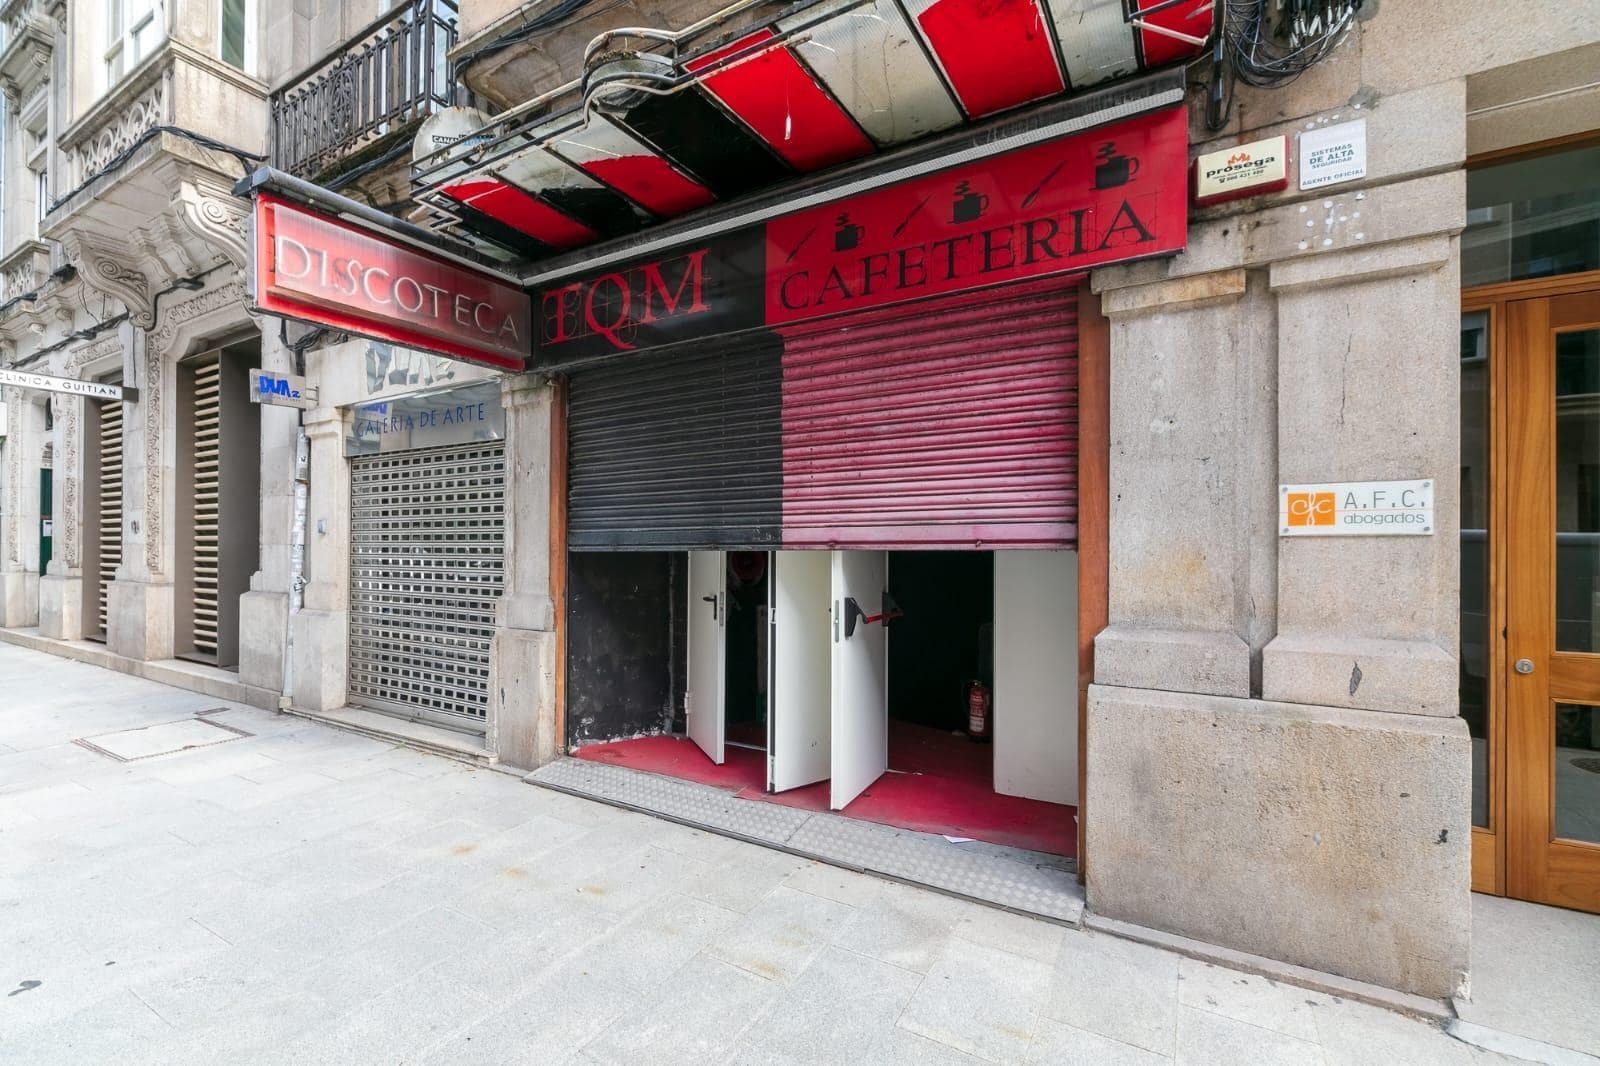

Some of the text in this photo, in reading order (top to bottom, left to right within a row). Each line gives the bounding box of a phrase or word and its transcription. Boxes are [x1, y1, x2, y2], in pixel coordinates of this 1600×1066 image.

[1309, 149, 1354, 165] DE ALTA
[1311, 143, 1352, 157] SISTEMAS
[1206, 156, 1275, 178] prosega
[1312, 157, 1352, 169] SEGURIDAD
[1302, 168, 1364, 186] AGENTE OFICIAL
[780, 199, 1156, 311] CAFETERIA
[275, 234, 520, 343] DISCOTECA
[542, 248, 712, 350] TQM
[62, 381, 117, 396] GUITIAN
[356, 402, 485, 438] GALERIA DE ARTE
[1344, 489, 1426, 509] A.F.C.
[1343, 512, 1426, 525] abogados
